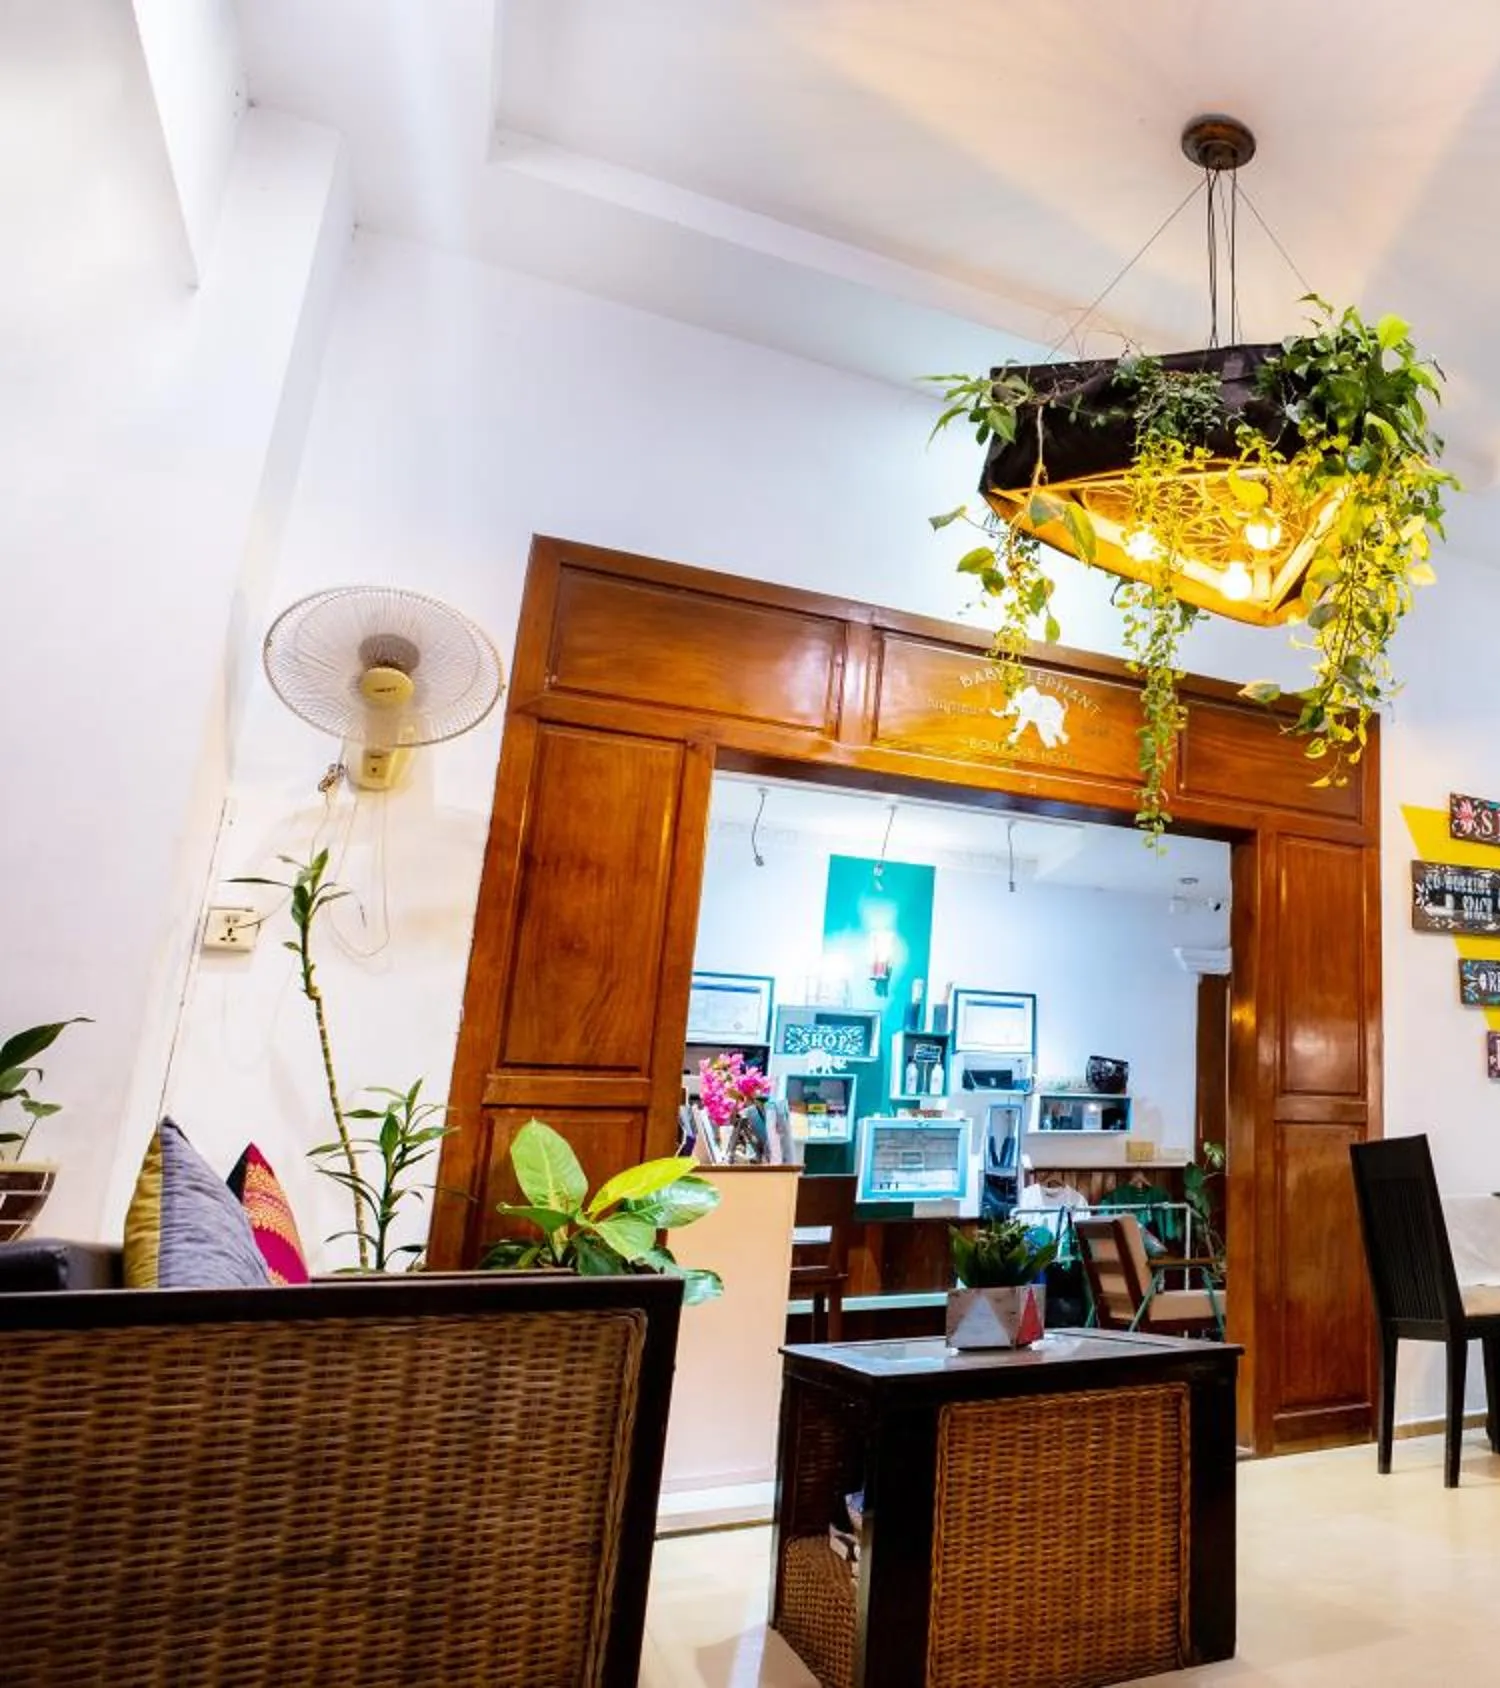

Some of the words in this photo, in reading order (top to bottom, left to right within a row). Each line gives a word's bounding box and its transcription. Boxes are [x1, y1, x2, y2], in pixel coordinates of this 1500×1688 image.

[959, 666, 1005, 689] BABY
[1024, 669, 1102, 717] LEPHANT
[1463, 895, 1493, 921] SPACE
[801, 1032, 848, 1051] SHOP
